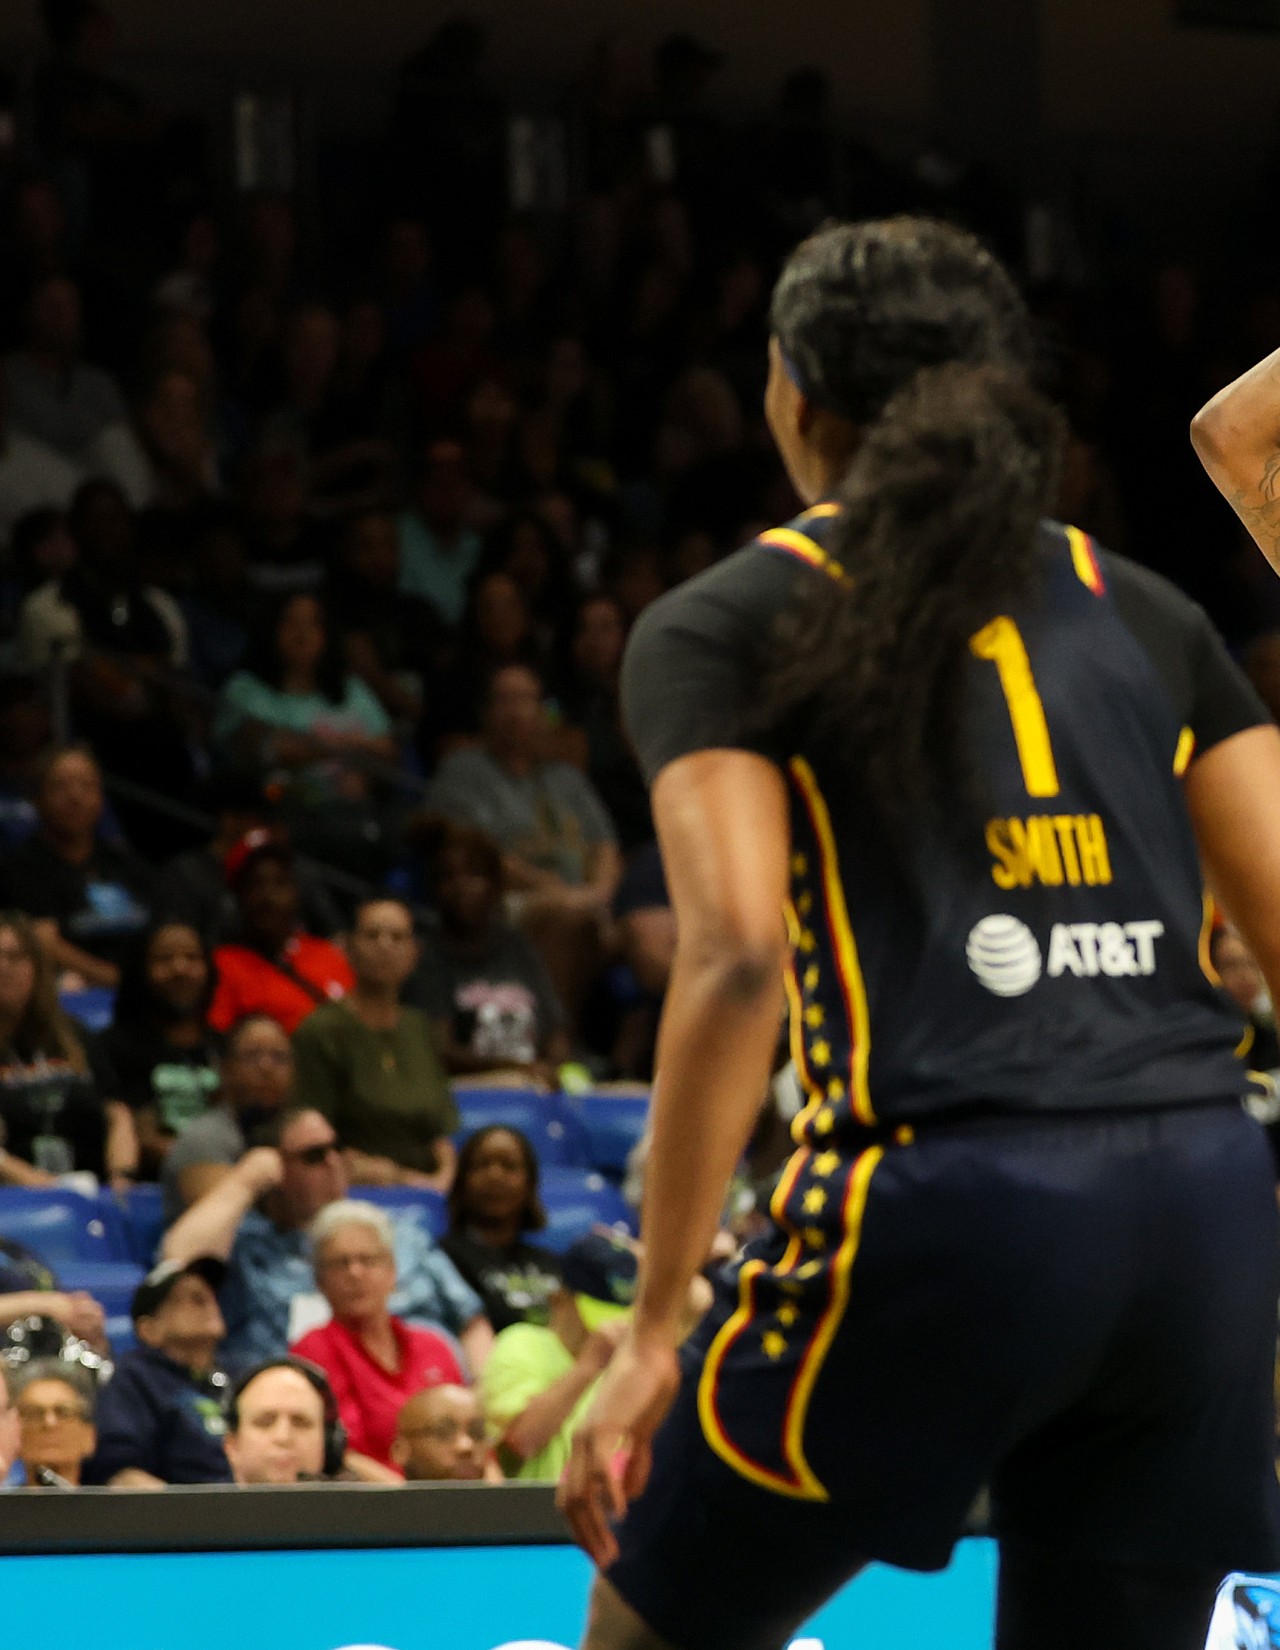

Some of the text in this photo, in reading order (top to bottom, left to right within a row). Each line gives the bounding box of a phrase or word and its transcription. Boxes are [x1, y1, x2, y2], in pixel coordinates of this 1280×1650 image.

[969, 615, 1061, 798] 1
[986, 814, 1113, 890] SMITH
[1046, 919, 1165, 978] AT&T
